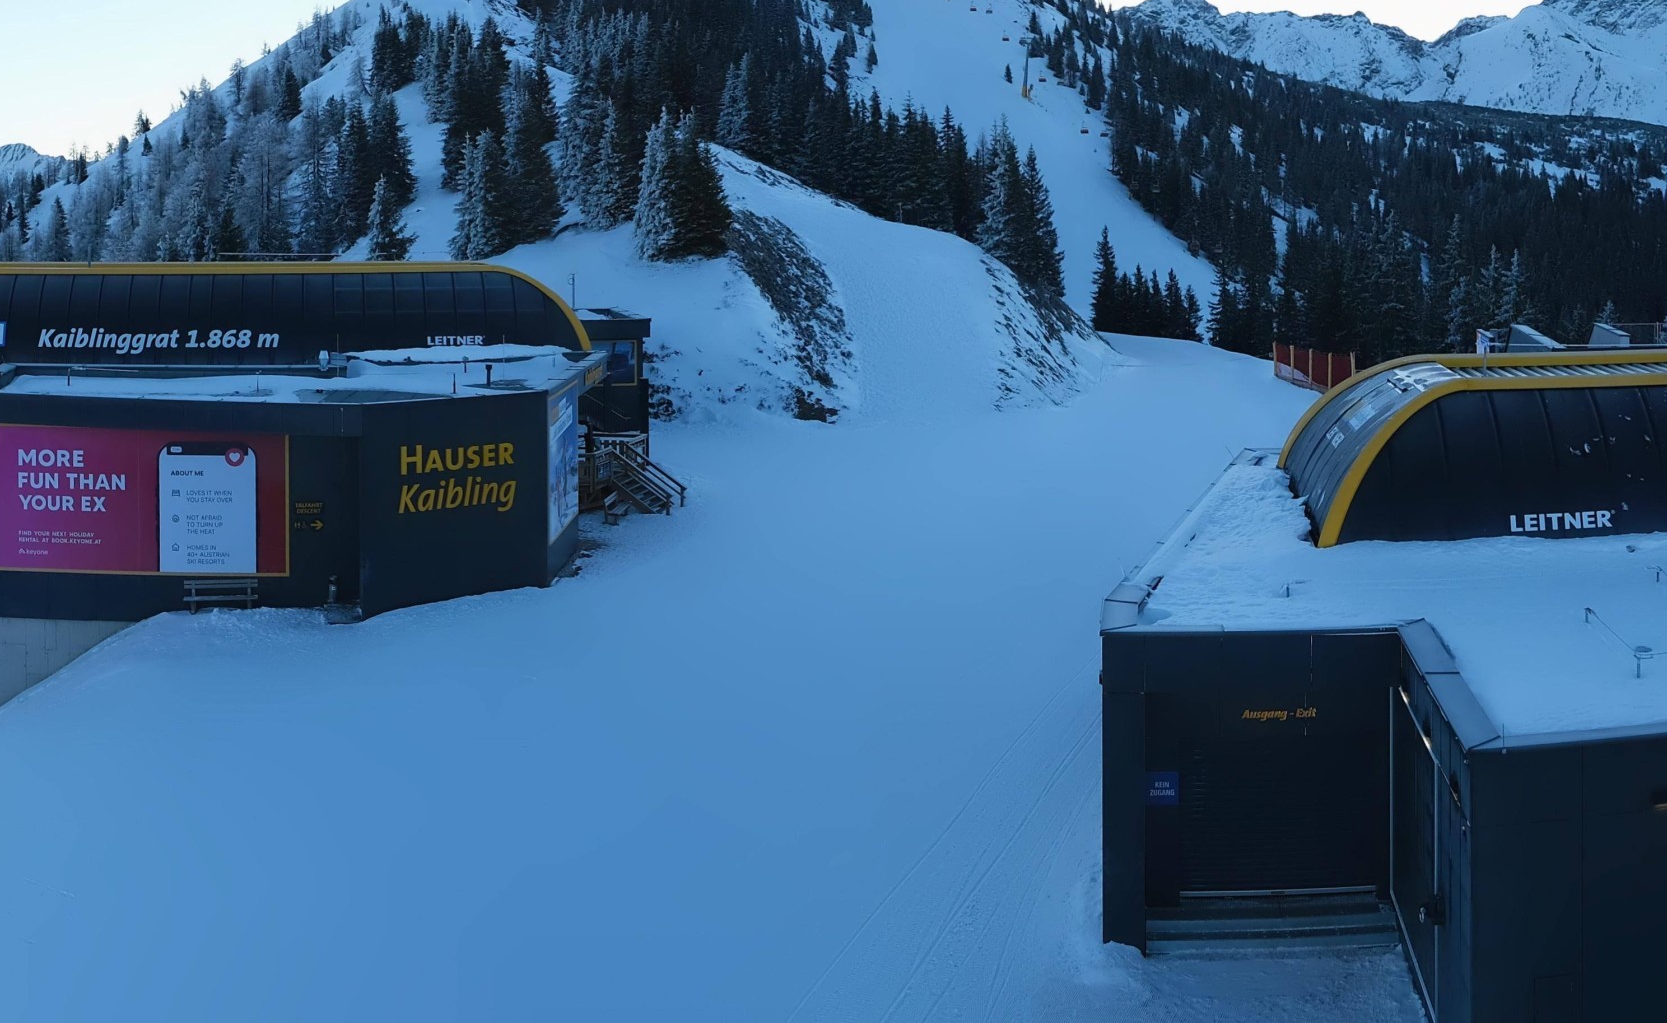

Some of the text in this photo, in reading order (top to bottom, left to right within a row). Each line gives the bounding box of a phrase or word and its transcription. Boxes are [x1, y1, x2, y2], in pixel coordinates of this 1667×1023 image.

[37, 328, 279, 355] Kaiblinggrat 1.868 m
[427, 335, 482, 346] LEITNER
[18, 448, 84, 468] MORE
[18, 472, 126, 491] FUN THAN
[398, 442, 517, 514] HAUSER Kaibling
[19, 494, 107, 513] YOUR EX
[1510, 510, 1613, 533] LEITNER
[1241, 708, 1288, 721] Ausgang
[1295, 706, 1317, 718] Exit
[1149, 789, 1175, 797] ZUGANG
